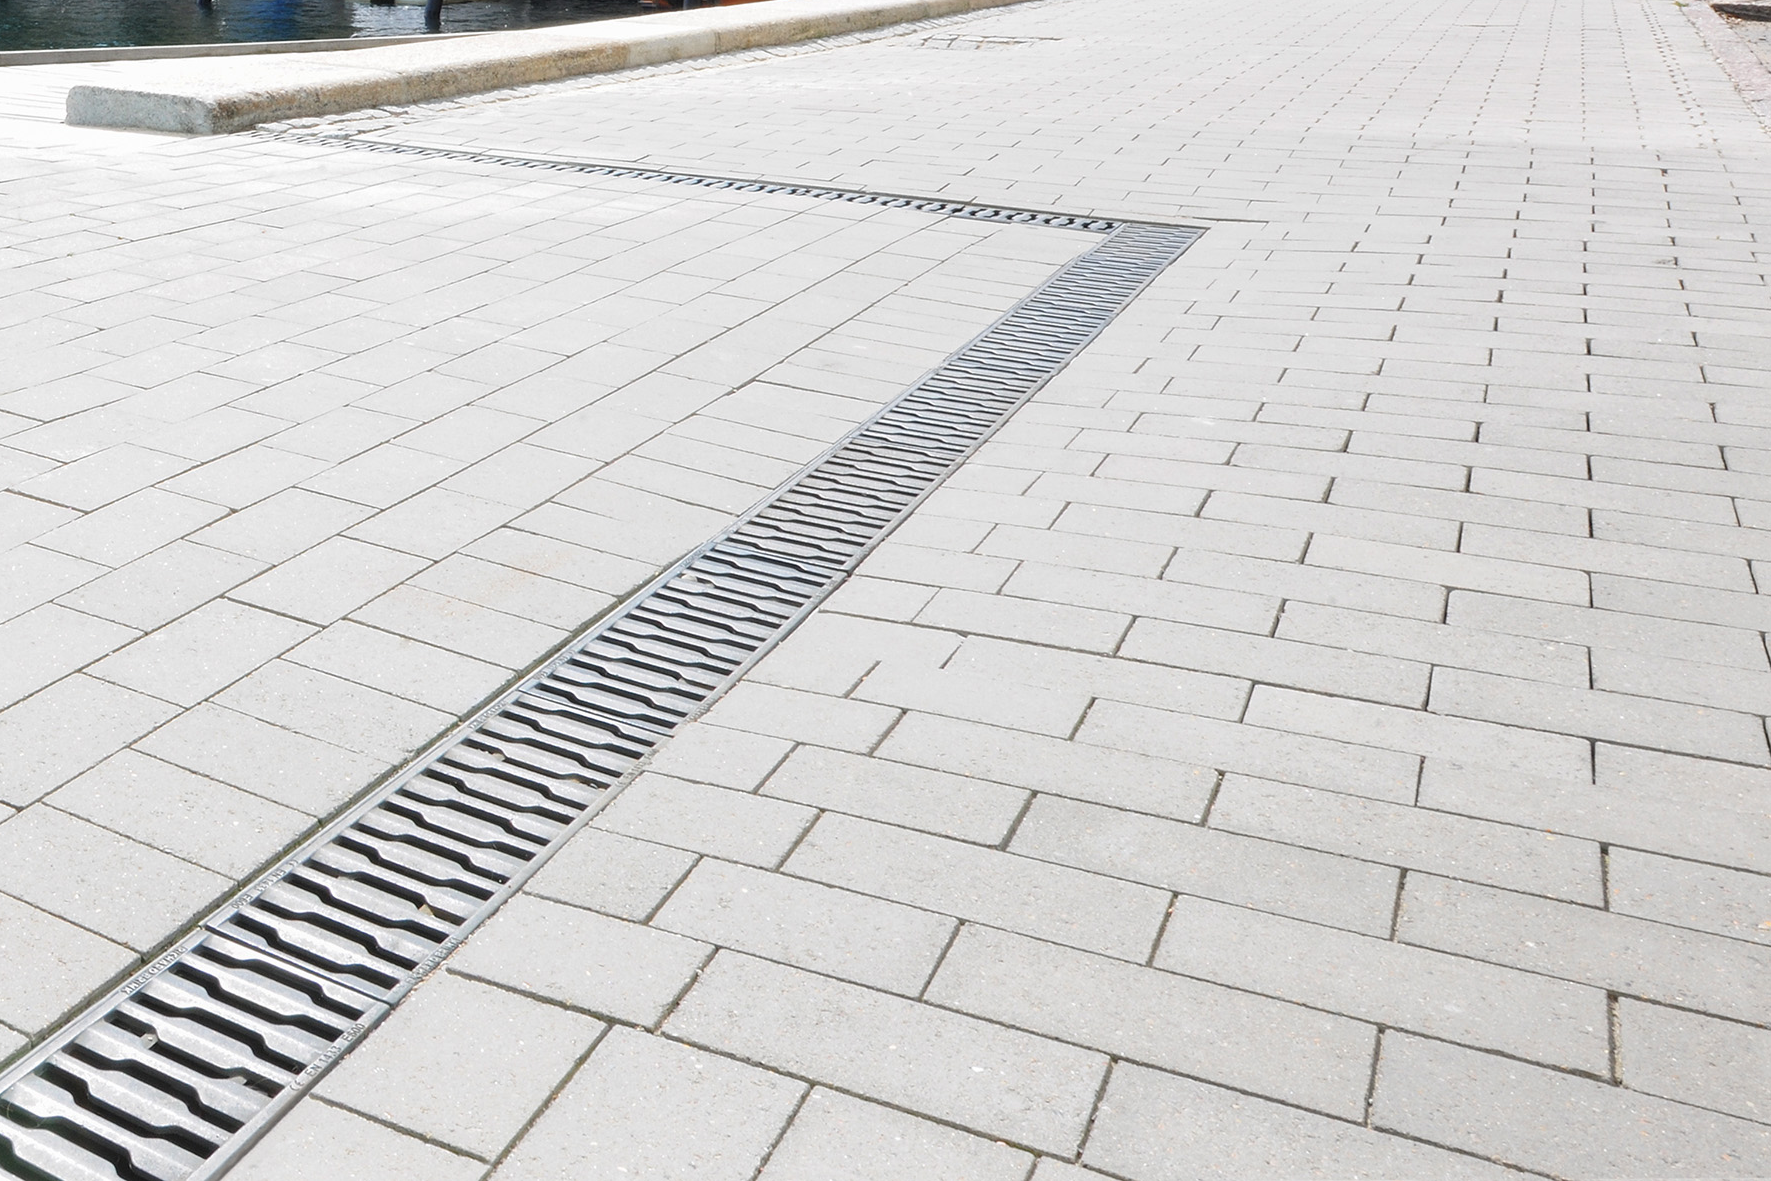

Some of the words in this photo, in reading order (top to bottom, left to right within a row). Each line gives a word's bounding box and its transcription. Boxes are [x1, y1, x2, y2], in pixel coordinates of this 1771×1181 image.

[304, 1063, 323, 1077] EN
[319, 1045, 342, 1064] 1433
[341, 1023, 366, 1042] E600
